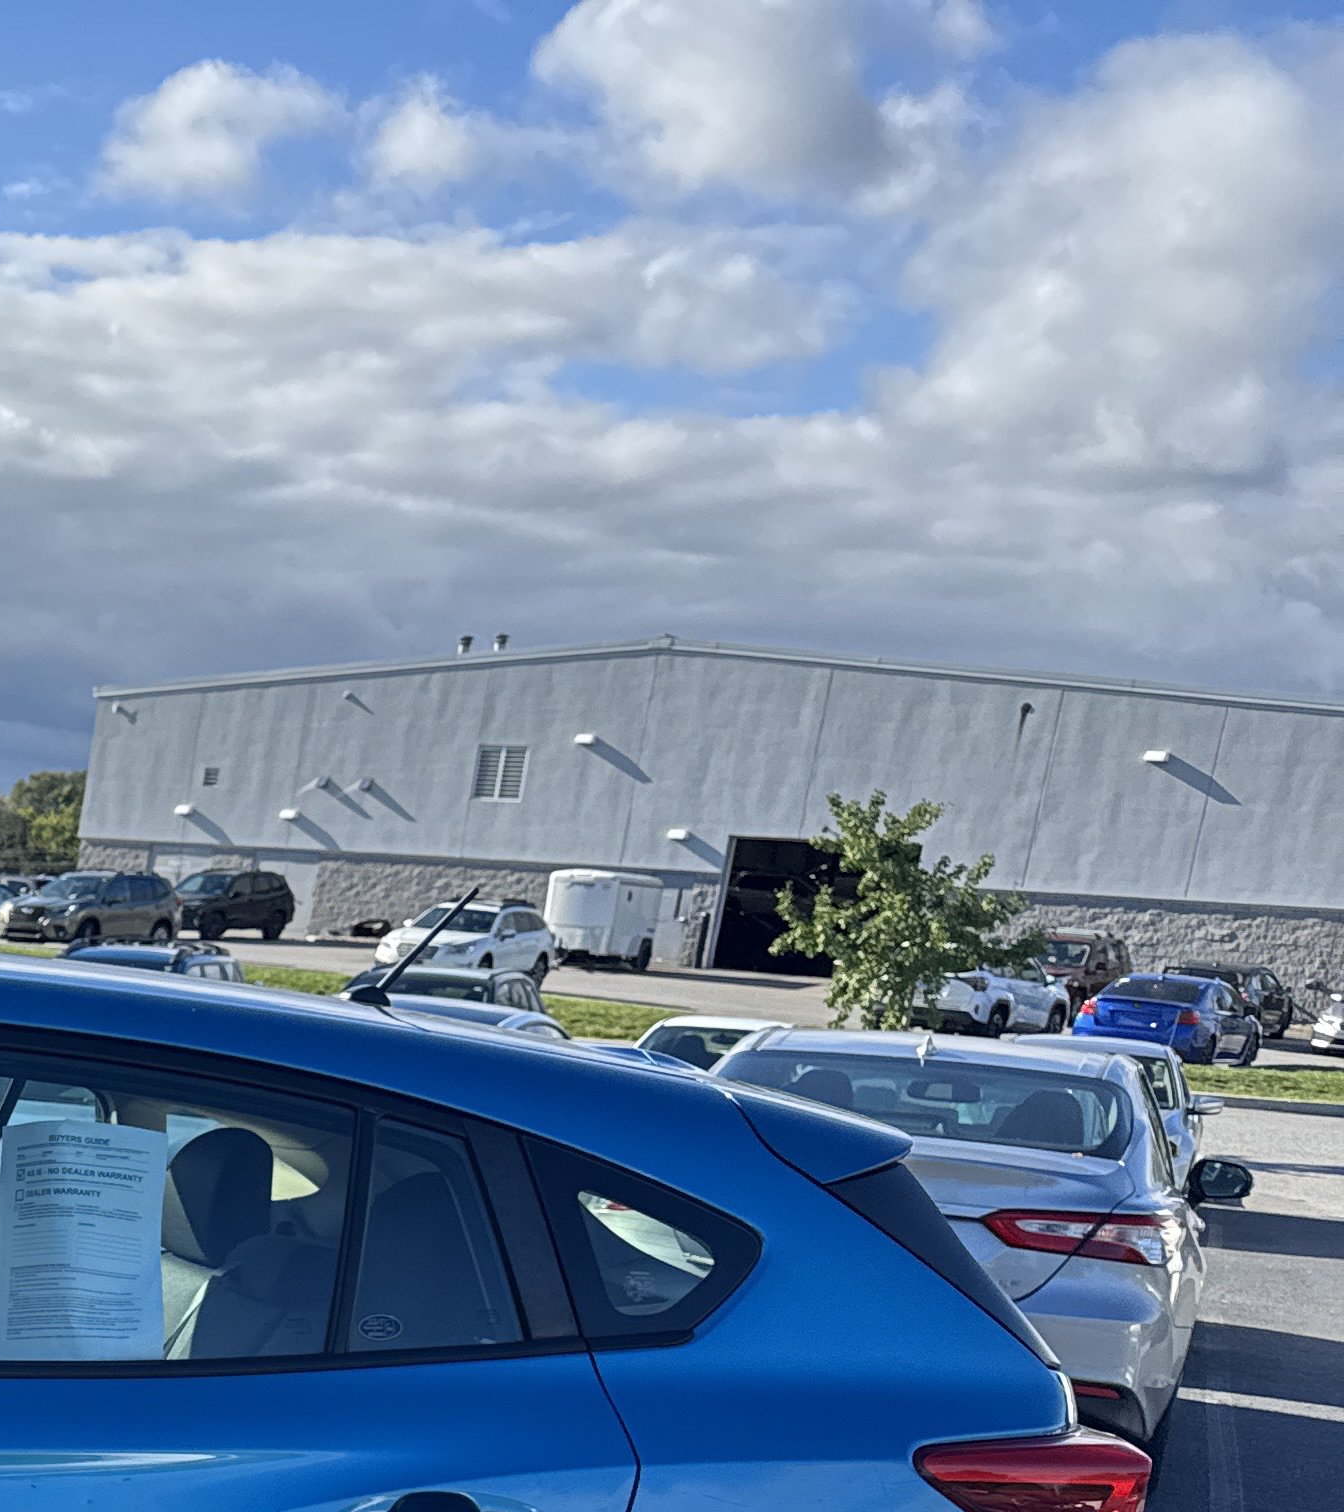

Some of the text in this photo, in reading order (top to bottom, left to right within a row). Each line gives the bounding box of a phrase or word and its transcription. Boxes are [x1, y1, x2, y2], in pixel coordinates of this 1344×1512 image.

[49, 1135, 111, 1146] BUYERS GUIDE
[48, 1167, 60, 1175] NO
[61, 1167, 96, 1177] DEALER
[96, 1170, 144, 1182] WARRANTY
[25, 1187, 101, 1198] DEALER WARRANTY
